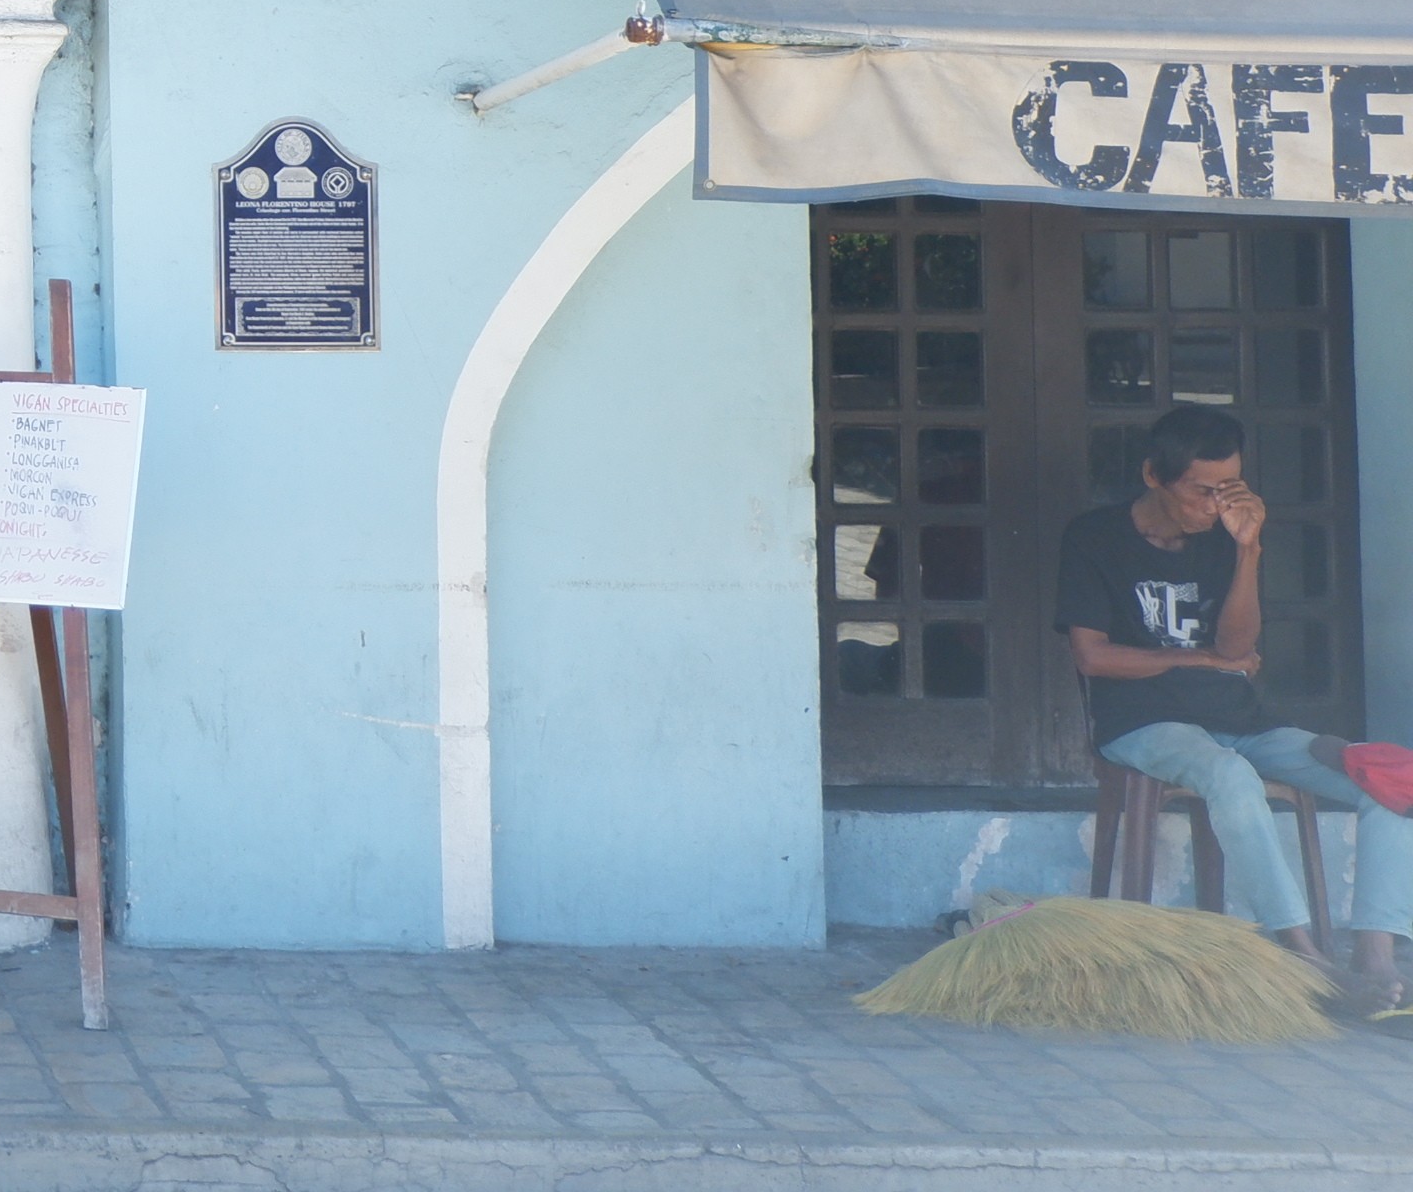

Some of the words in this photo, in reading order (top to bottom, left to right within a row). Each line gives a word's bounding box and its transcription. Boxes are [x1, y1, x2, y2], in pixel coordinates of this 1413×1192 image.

[1011, 60, 1413, 203] CAFE
[13, 394, 51, 411] VIGAN
[15, 417, 63, 432] BAGNET
